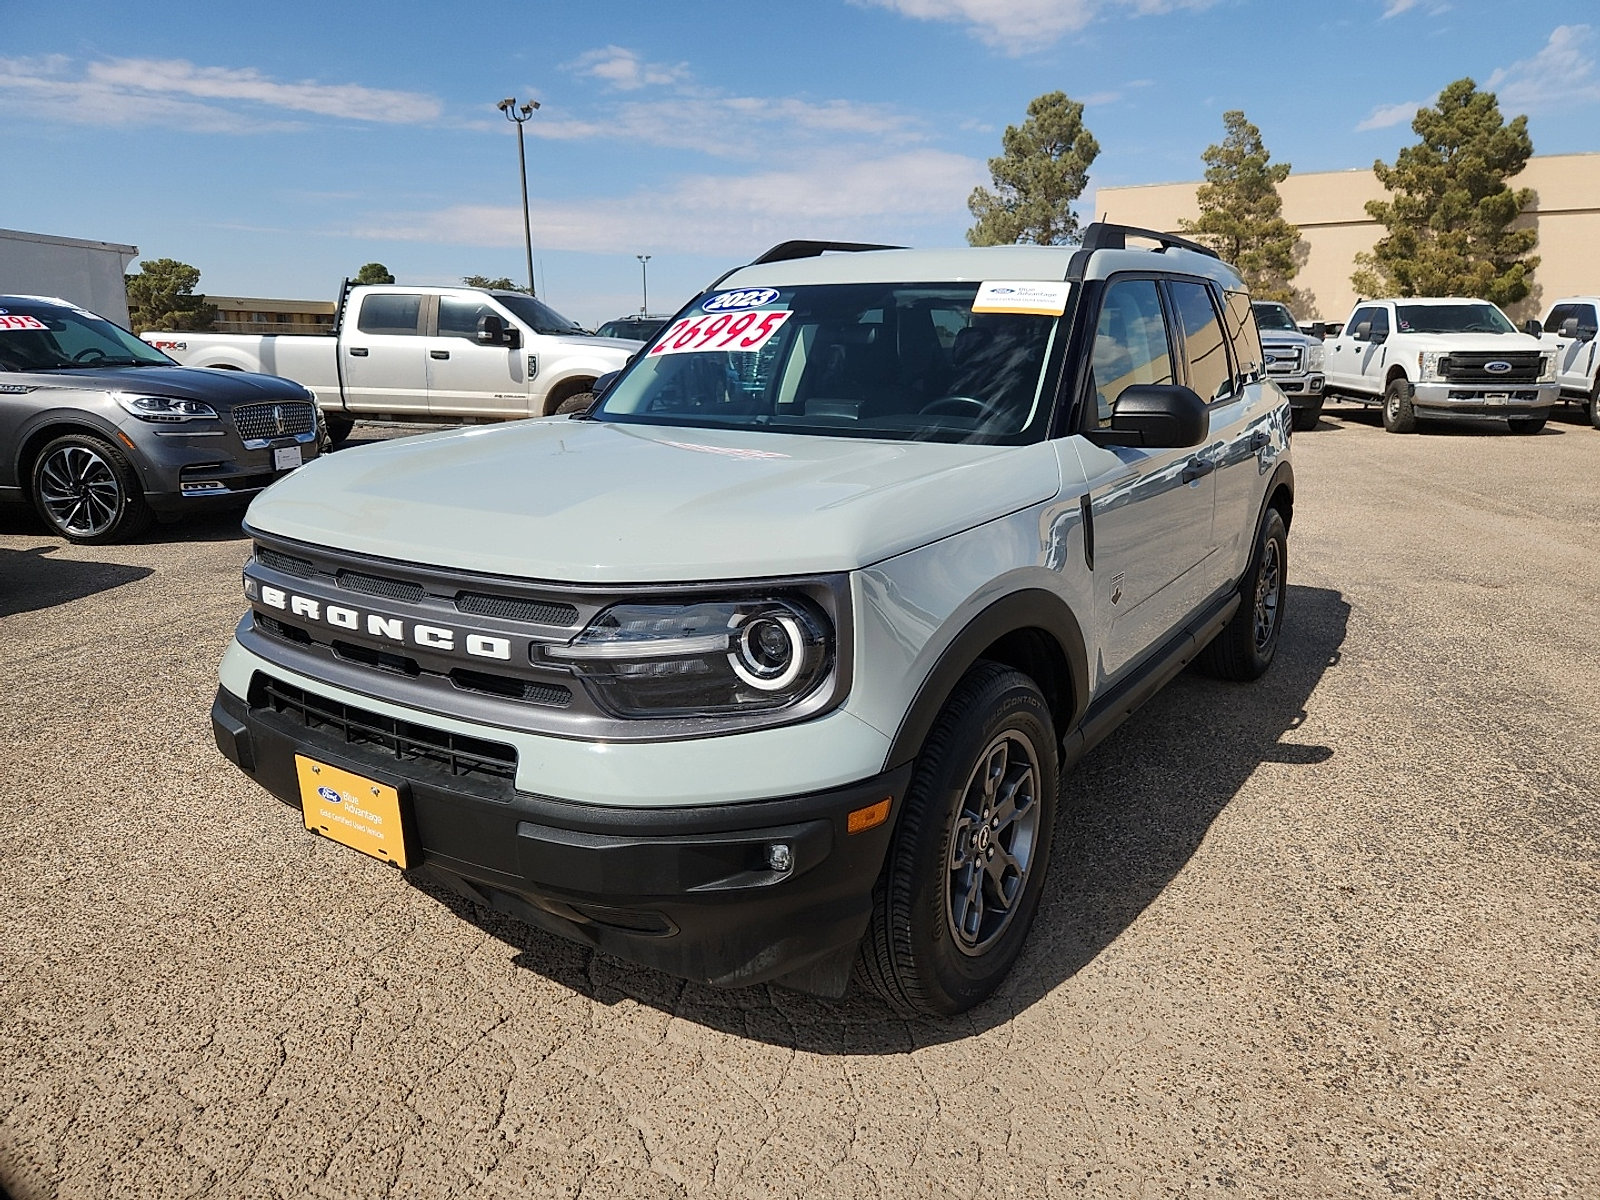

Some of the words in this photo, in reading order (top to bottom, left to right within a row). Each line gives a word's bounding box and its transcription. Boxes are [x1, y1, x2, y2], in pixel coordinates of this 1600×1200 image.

[705, 290, 776, 310] 2023
[650, 312, 789, 355] 26995
[155, 341, 187, 351] FX4
[261, 585, 512, 661] BRONCO
[319, 787, 340, 803] Ford
[342, 791, 359, 804] Blue
[344, 802, 383, 824] Advantage
[352, 821, 366, 832] Used
